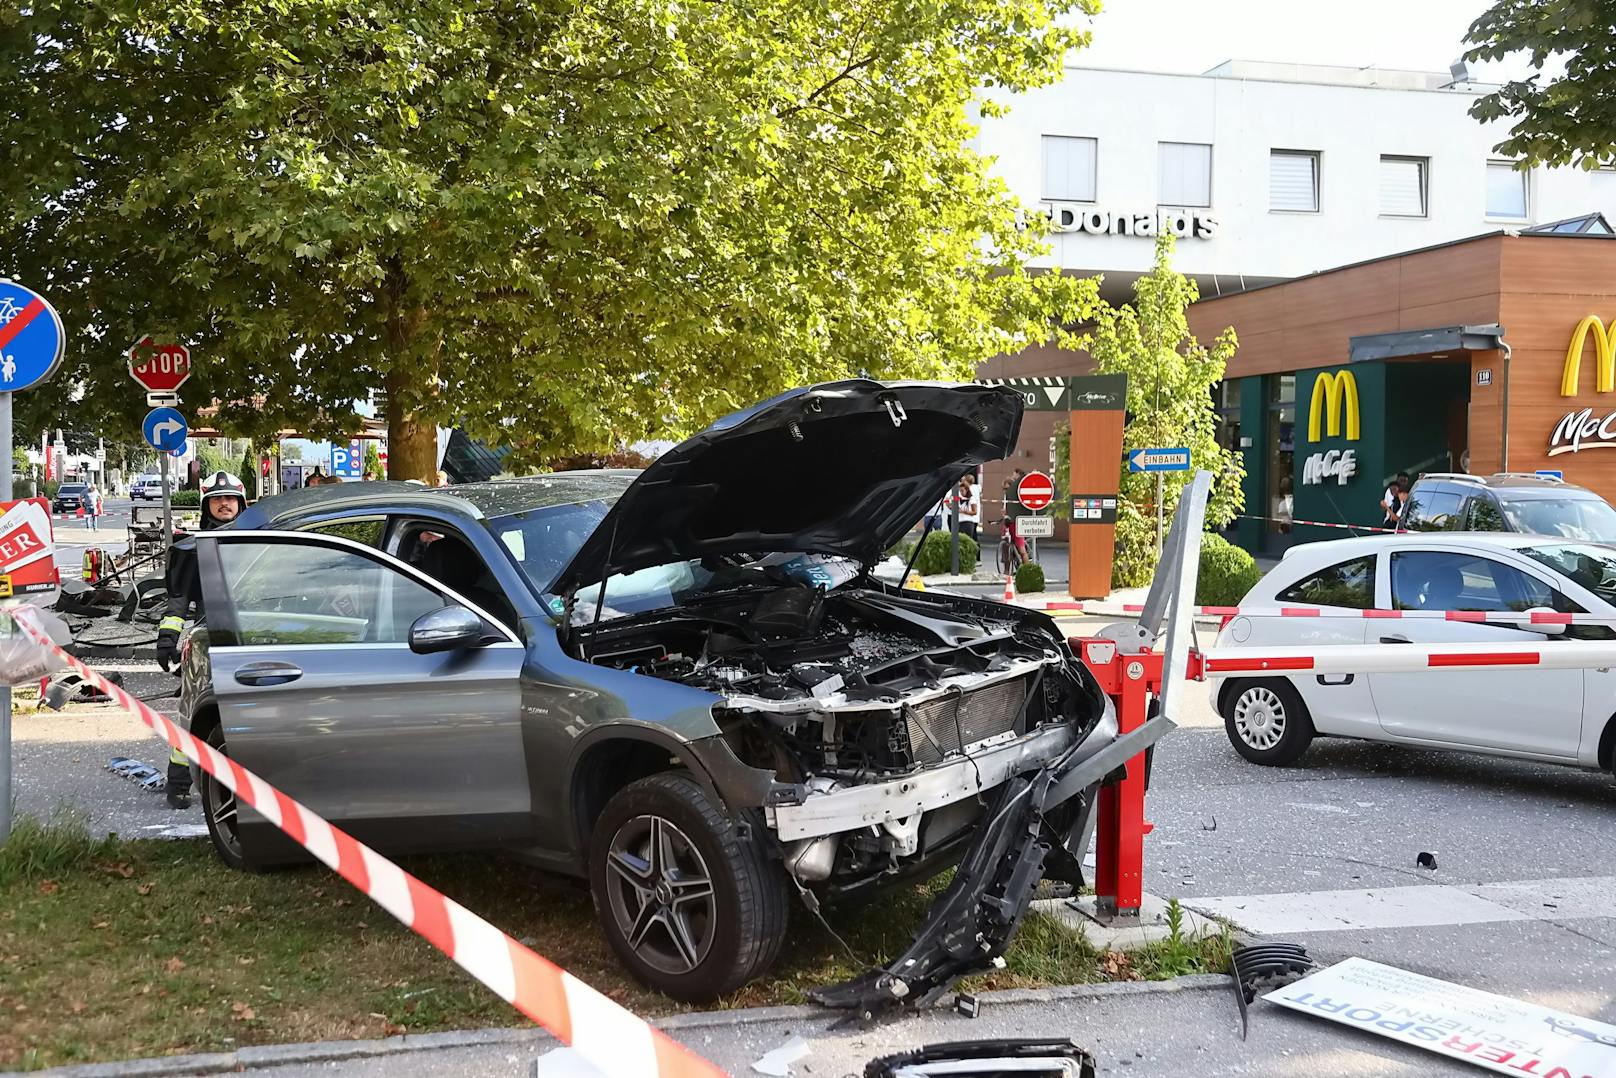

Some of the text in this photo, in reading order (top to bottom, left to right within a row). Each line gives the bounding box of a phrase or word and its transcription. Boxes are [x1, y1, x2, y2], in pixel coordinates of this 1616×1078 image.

[1014, 203, 1219, 240] Donald's
[1143, 455, 1182, 464] EINBAHN
[1376, 1001, 1544, 1057] TSCHERNE
